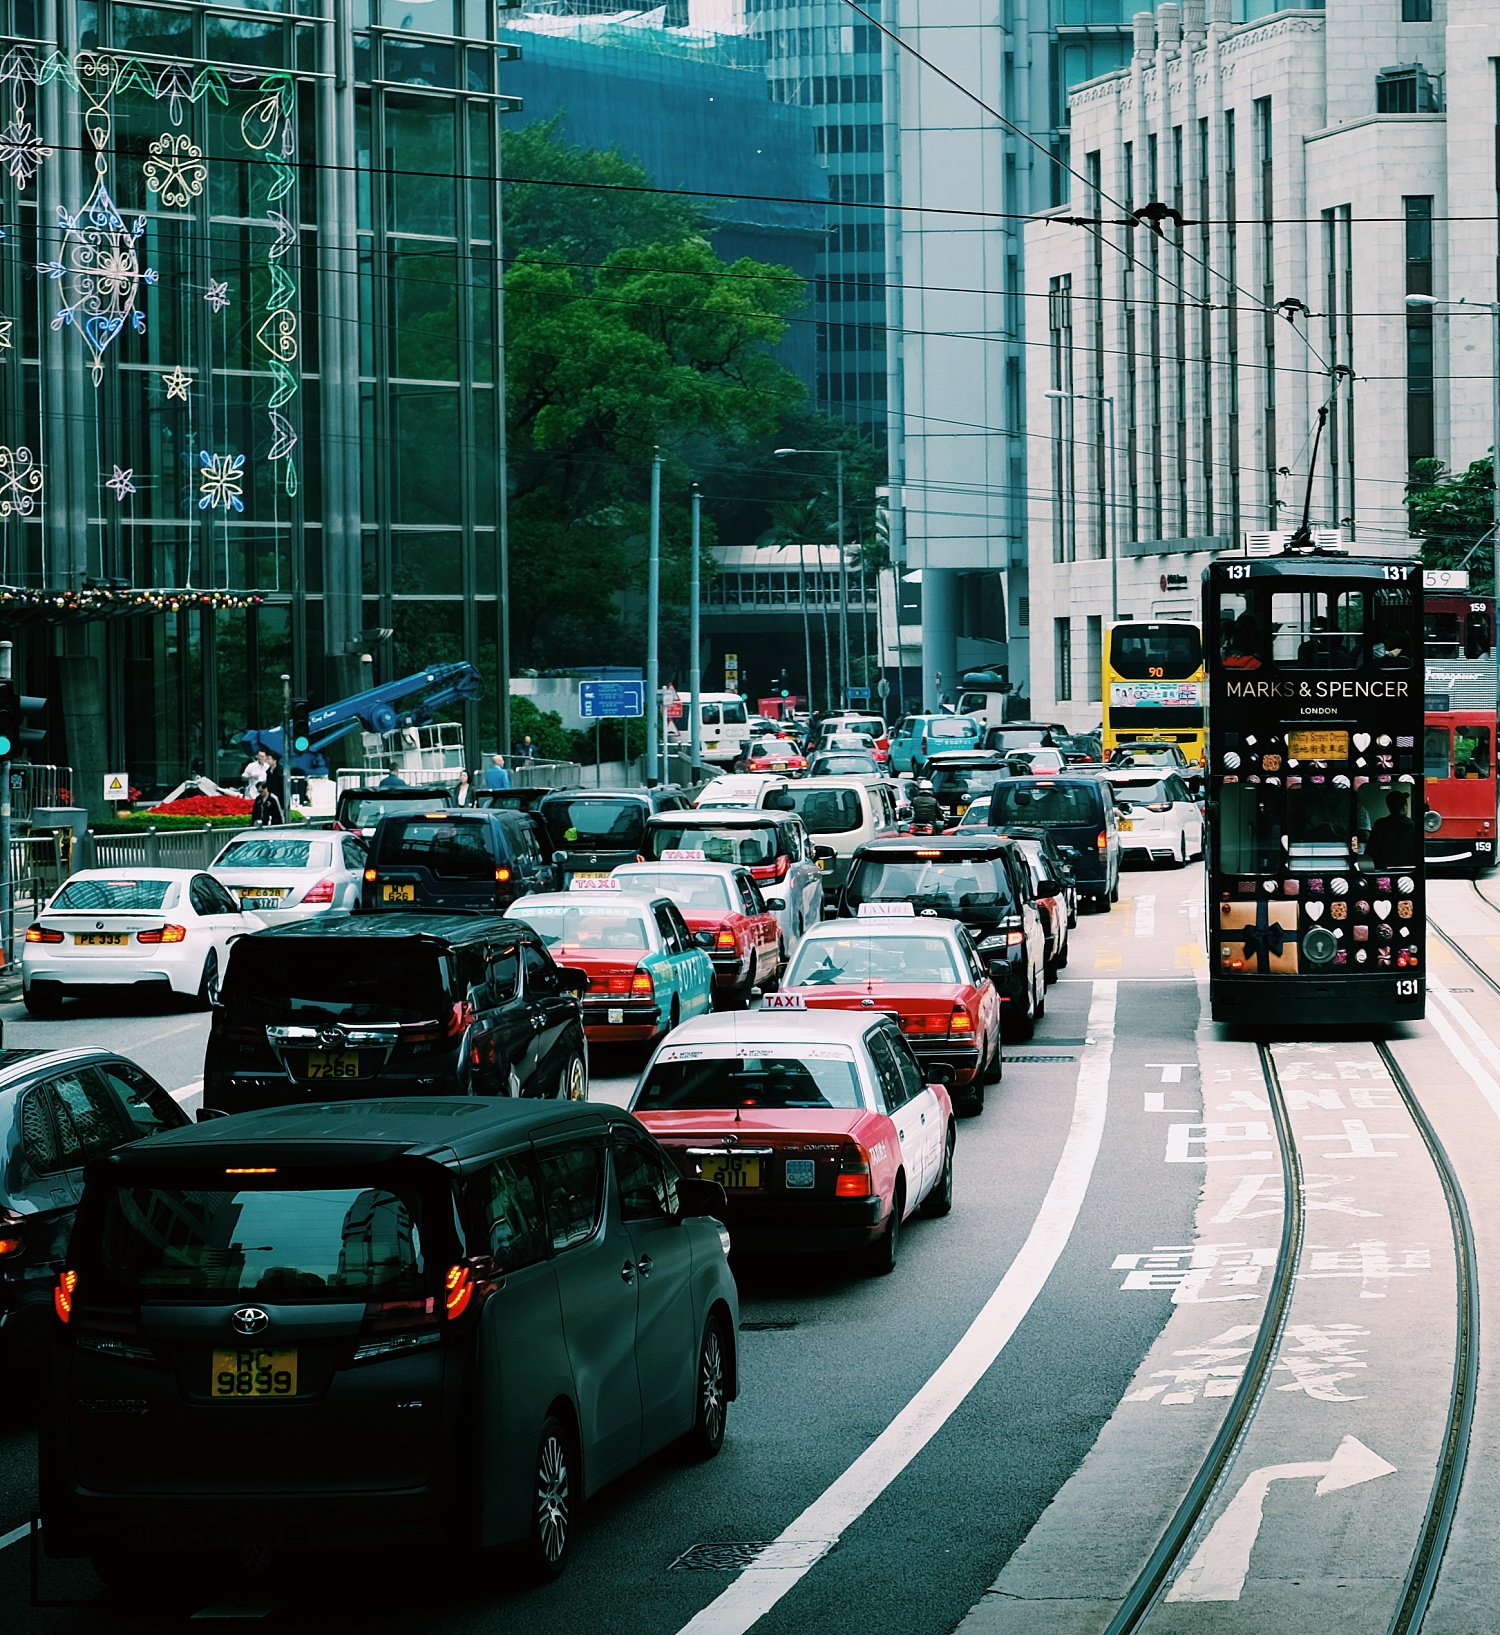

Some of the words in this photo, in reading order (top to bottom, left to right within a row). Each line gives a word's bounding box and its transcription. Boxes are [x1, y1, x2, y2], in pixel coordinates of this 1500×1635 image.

[1226, 565, 1251, 579] 131
[1381, 565, 1408, 580] 131
[1469, 602, 1487, 612] 159
[1148, 667, 1164, 678] 90
[1227, 681, 1295, 697] MARKS
[1299, 681, 1312, 697] &
[1315, 681, 1409, 697] SPENCER
[1300, 707, 1338, 715] LONDON
[1475, 841, 1492, 852] 159
[665, 850, 701, 860] TAXI
[575, 880, 617, 888] TAXI
[388, 892, 409, 900] 626
[863, 905, 890, 914] TAXI
[80, 934, 97, 945] PE
[100, 934, 121, 945] 335
[1396, 979, 1418, 995] 131
[765, 996, 800, 1007] TAXI
[310, 1064, 356, 1077] 7266
[1144, 1088, 1403, 1113] LANE
[1164, 1118, 1411, 1162] 巴士
[717, 1156, 743, 1172] JG
[1109, 1239, 1433, 1304] 電車
[236, 1351, 273, 1372] RC
[216, 1371, 292, 1394] 9899
